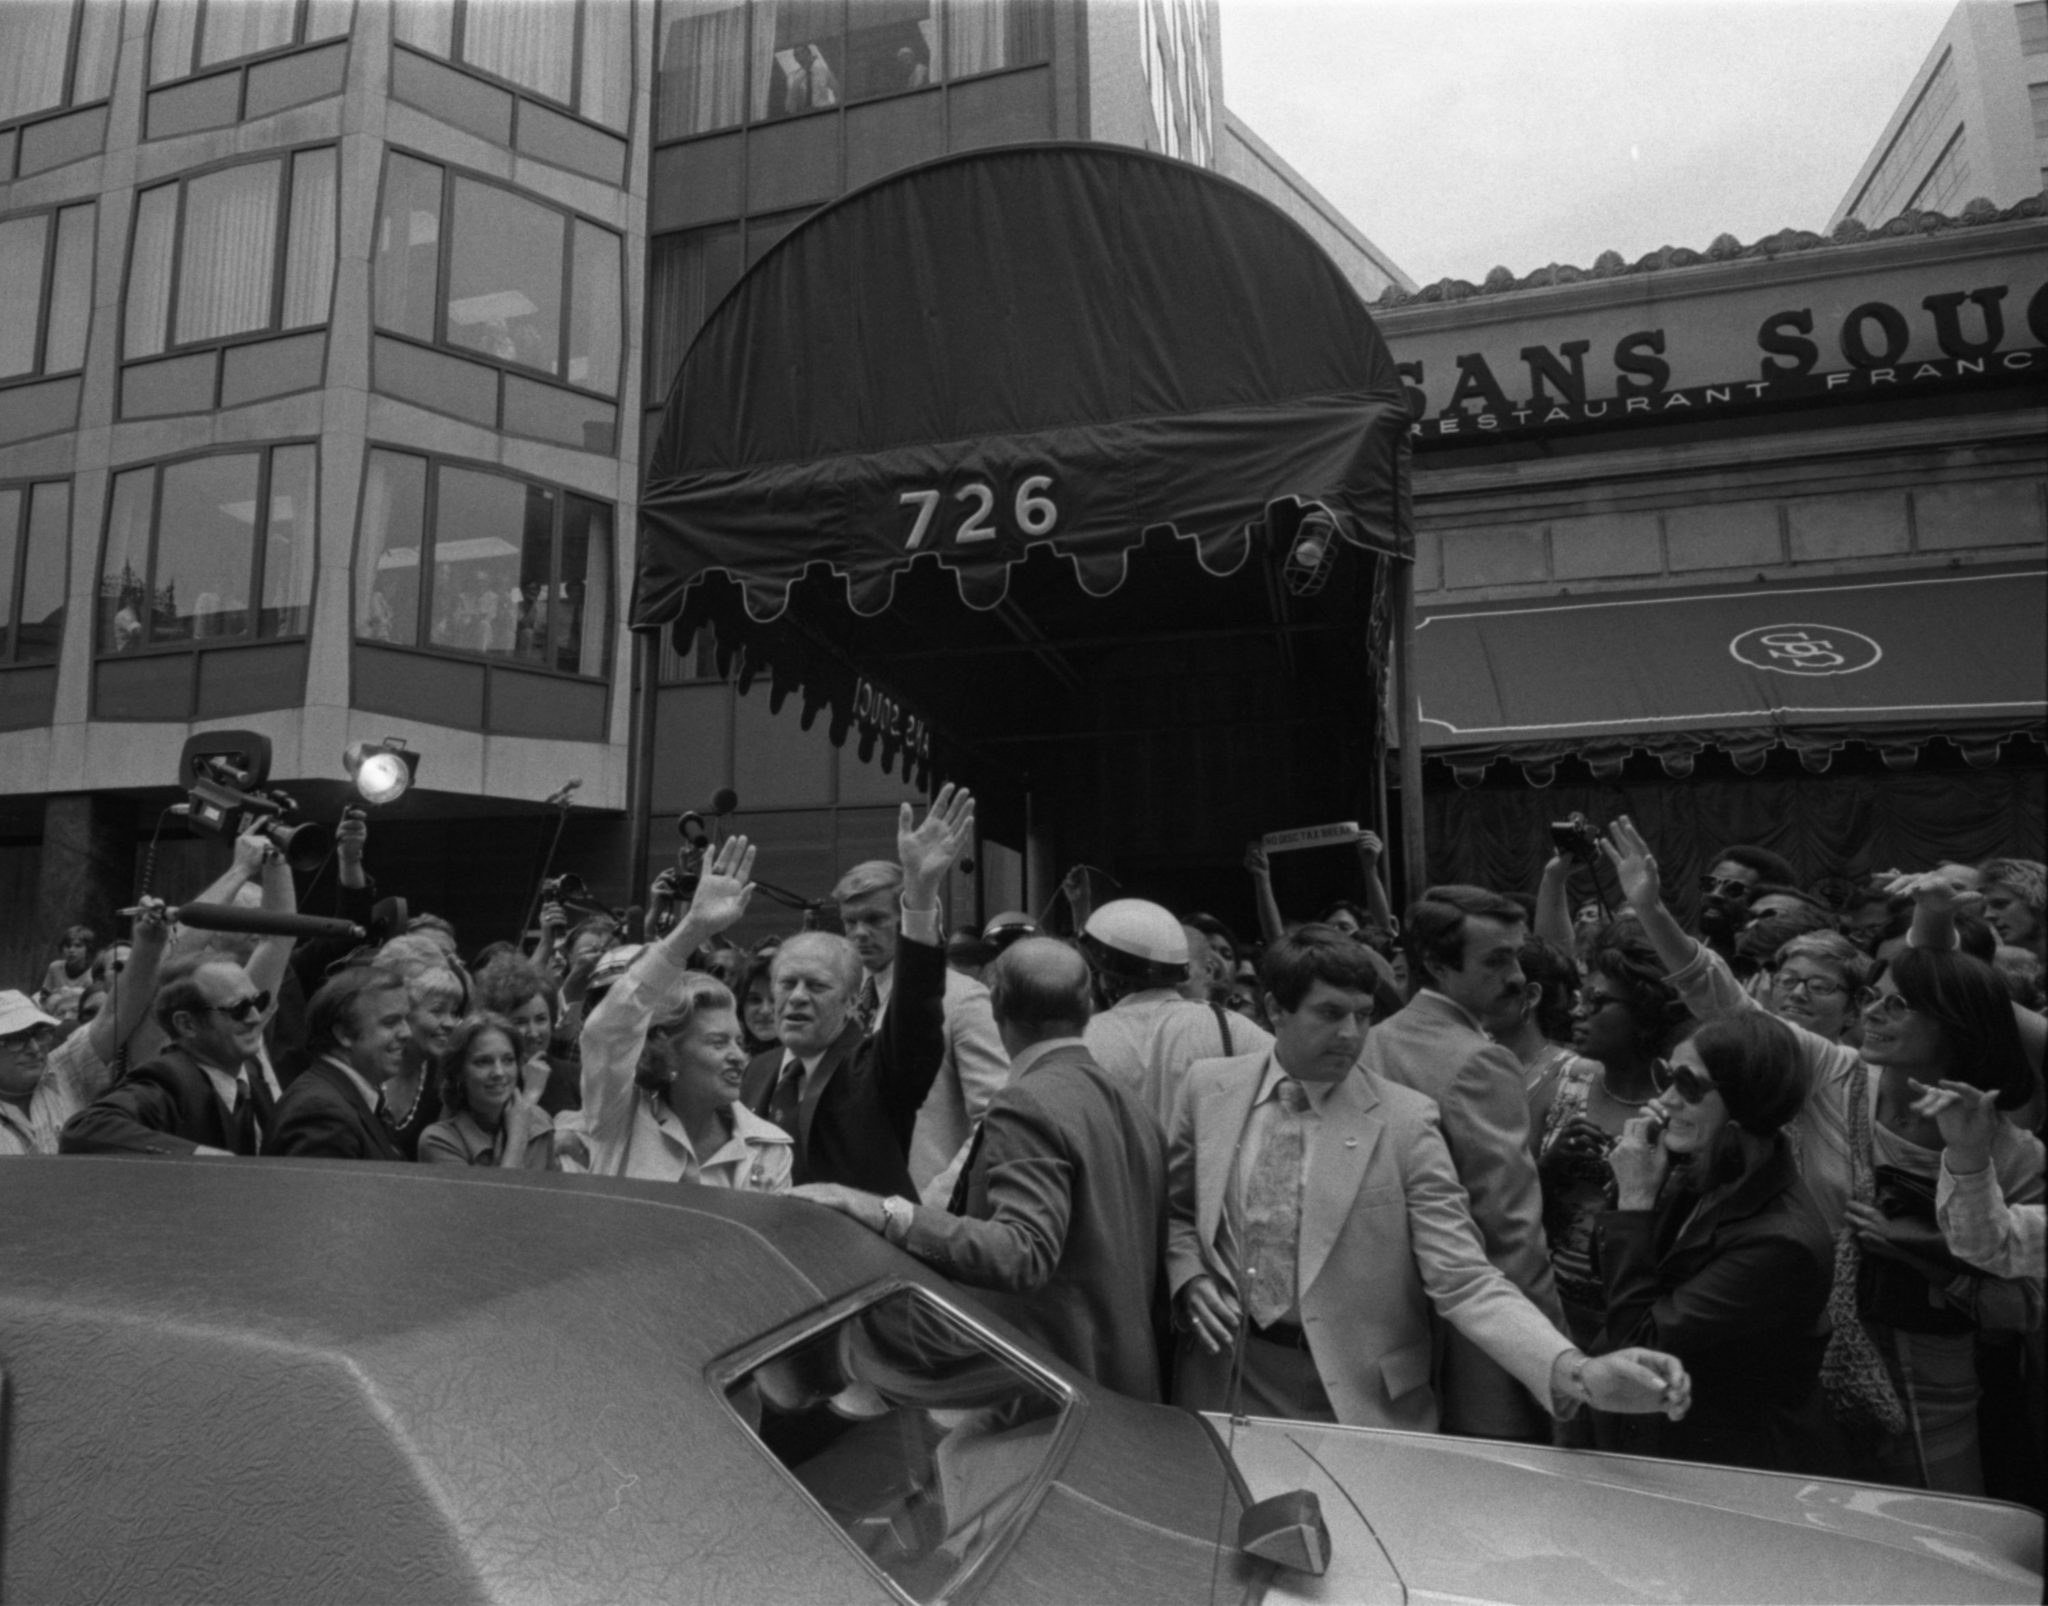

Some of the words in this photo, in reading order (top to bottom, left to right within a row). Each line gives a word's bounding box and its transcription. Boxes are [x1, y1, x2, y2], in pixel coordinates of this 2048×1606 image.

[1396, 329, 1672, 423] SANS
[1758, 281, 2048, 378] SOU
[1408, 382, 1770, 435] RESTAURANT
[1826, 351, 2033, 390] FRANC
[900, 475, 1058, 549] 726
